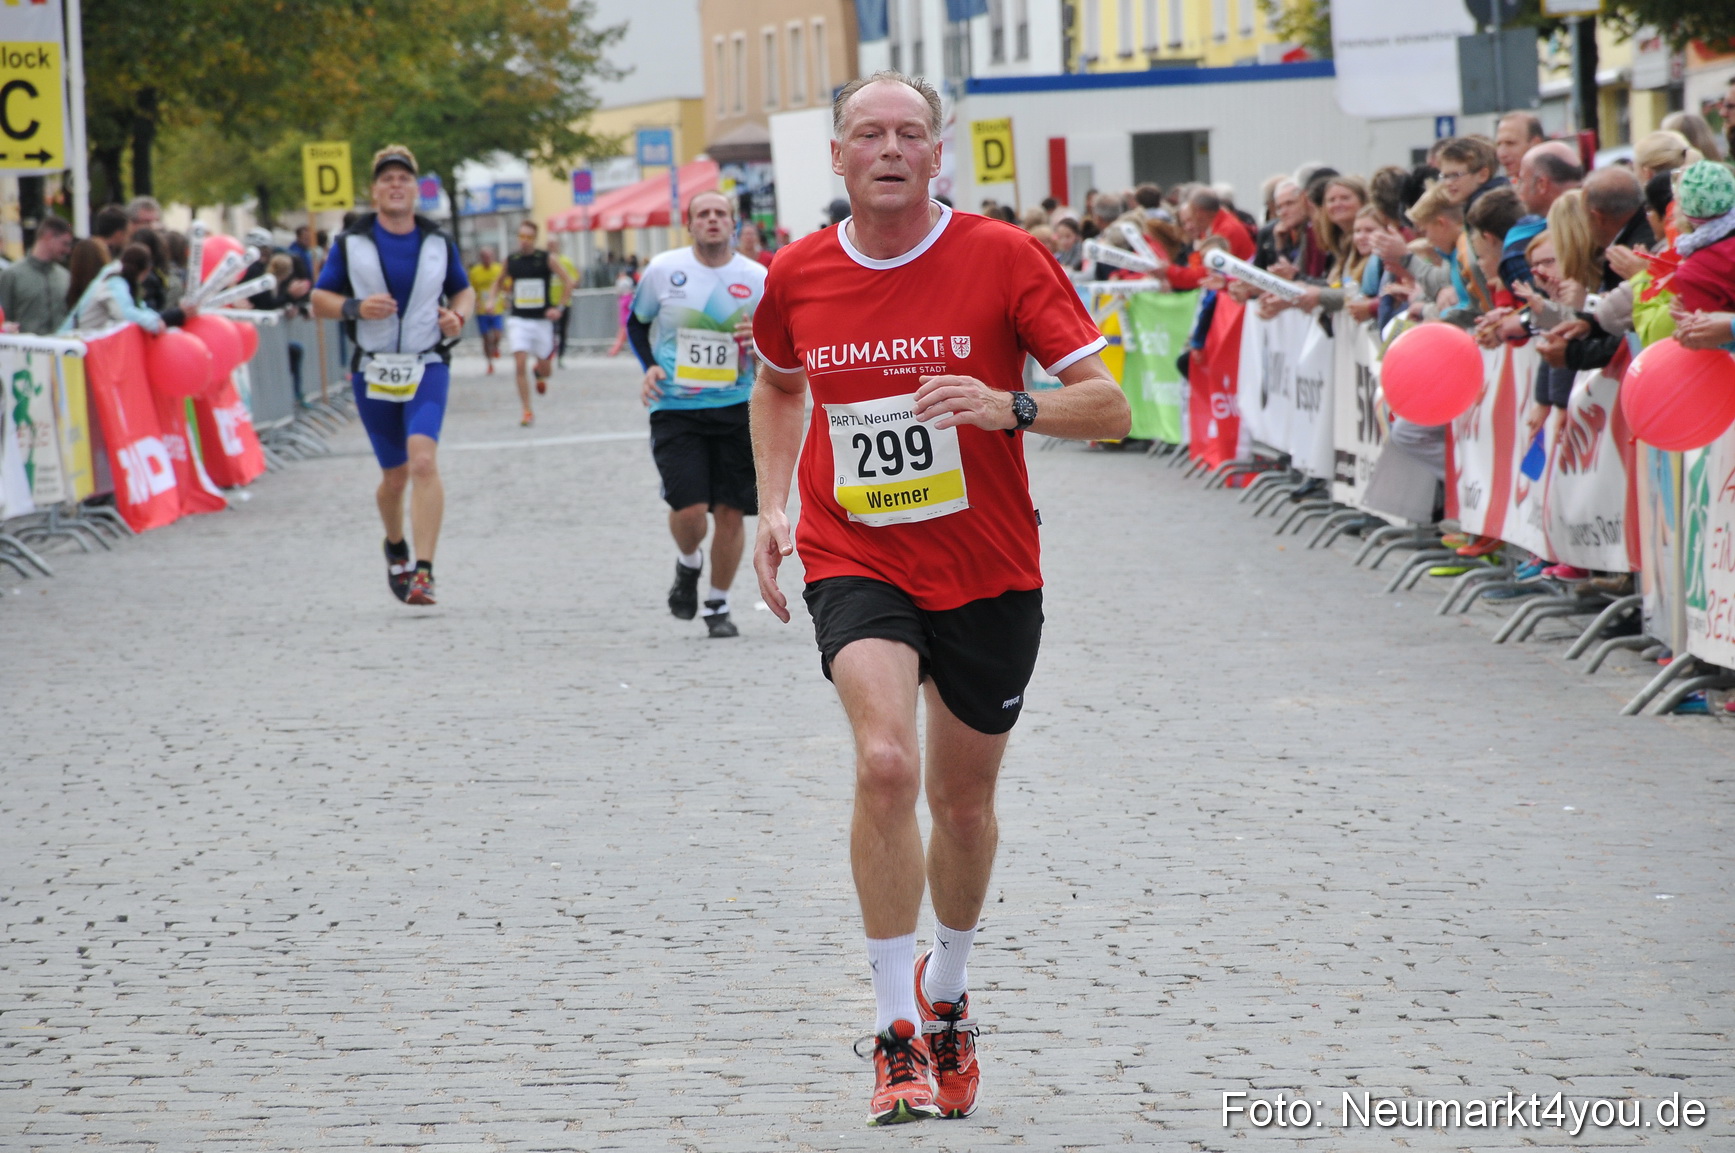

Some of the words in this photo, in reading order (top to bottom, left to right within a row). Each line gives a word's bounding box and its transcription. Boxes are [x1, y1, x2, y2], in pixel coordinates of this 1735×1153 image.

[2, 46, 50, 69] lock
[0, 79, 40, 141] C
[983, 138, 1005, 169] D
[317, 164, 340, 195] D
[690, 344, 727, 366] 518
[806, 336, 943, 371] NEUMARKT
[379, 367, 413, 383] 287
[883, 366, 917, 376] STARKE
[919, 365, 946, 374] STADT
[830, 415, 863, 427] PARTL
[864, 410, 914, 426] Neumar
[852, 425, 933, 478] 299
[866, 487, 930, 509] Werner
